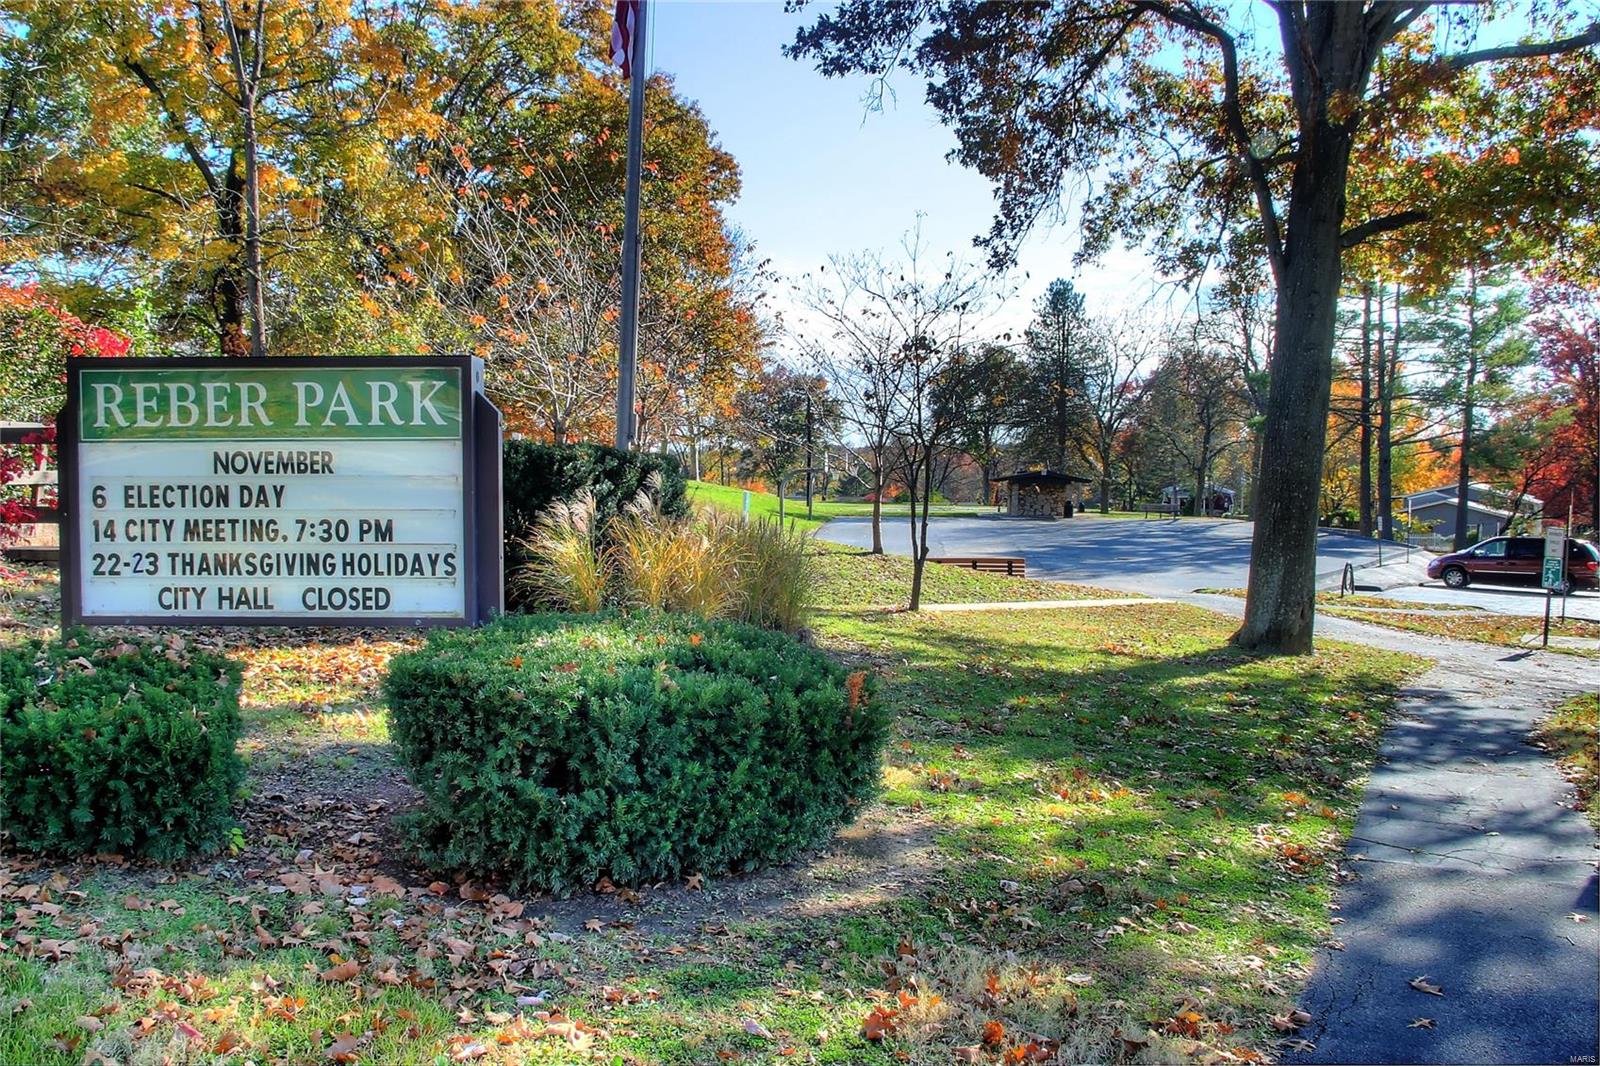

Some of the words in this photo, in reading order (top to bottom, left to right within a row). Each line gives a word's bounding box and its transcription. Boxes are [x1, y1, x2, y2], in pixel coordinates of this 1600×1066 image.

[91, 382, 274, 427] REBER
[292, 380, 447, 426] PARK
[213, 451, 334, 474] NOVEMBER
[92, 485, 107, 508] 6
[124, 485, 229, 508] ELECTION
[240, 485, 285, 508] DAY
[92, 519, 116, 542] 14
[125, 519, 175, 542] CITY
[295, 519, 349, 542] 7:30
[359, 519, 393, 542] PM
[92, 553, 159, 576] 22-23
[167, 553, 337, 576] THANKSGIVING
[342, 553, 457, 576] HOLIDAYS
[158, 587, 207, 610] CITY
[218, 587, 274, 610] HALL
[302, 587, 391, 611] CLOSED
